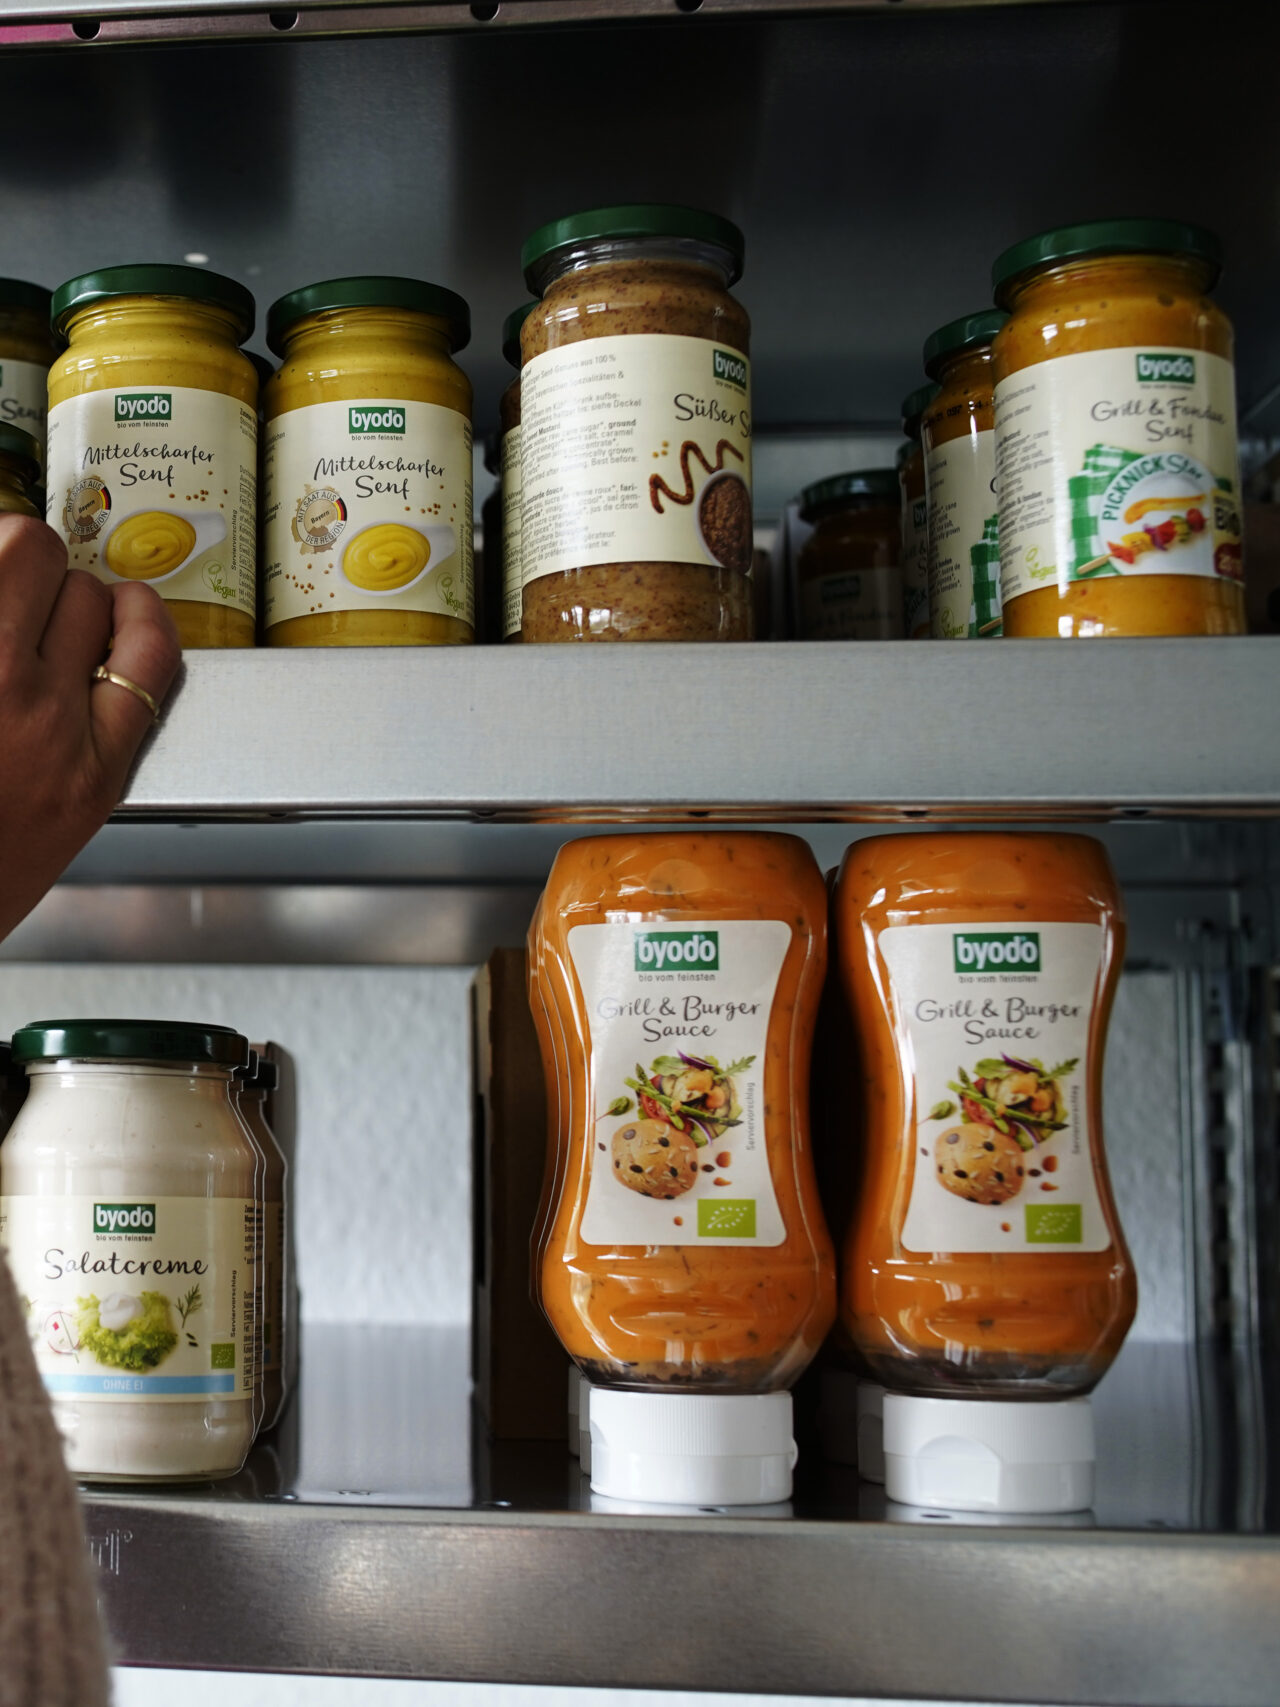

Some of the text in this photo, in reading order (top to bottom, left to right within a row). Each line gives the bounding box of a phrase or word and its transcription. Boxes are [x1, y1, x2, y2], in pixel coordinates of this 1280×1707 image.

[715, 352, 747, 387] byodo
[1138, 356, 1196, 380] byodo
[117, 396, 170, 419] byodo
[614, 398, 642, 409] Deckel
[674, 393, 738, 425] Süßer
[1091, 400, 1144, 422] Grill
[1147, 399, 1166, 416] &
[351, 409, 404, 431] byodo
[608, 419, 636, 429] ground
[378, 434, 403, 442] feinsten
[601, 428, 633, 438] caramel
[82, 442, 216, 470] Mittelscharfer
[313, 455, 446, 481] Mittelscharfer
[88, 480, 102, 491] AUS
[119, 463, 175, 488] Senf
[355, 475, 411, 500] Senf
[302, 491, 321, 509] SAAT
[320, 491, 337, 502] AUS
[1102, 456, 1166, 521] PICKNICK
[86, 511, 108, 534] REGION
[310, 510, 330, 525] Bayern
[305, 521, 344, 546] DER REGION
[639, 935, 716, 968] byodo
[957, 936, 1038, 969] byodo
[638, 973, 716, 982] bio vom feinsten
[958, 974, 1038, 983] bio vom feinsten
[597, 995, 760, 1023] Grill & Burger
[915, 997, 1082, 1024] Grill & Burger
[643, 1017, 718, 1043] Sauce
[964, 1019, 1041, 1045] Sauce
[746, 1082, 756, 1151] Serviervorschlag
[96, 1206, 153, 1231] byodo
[44, 1248, 209, 1280] Salatcreme
[103, 1380, 144, 1391] OHNE EI
